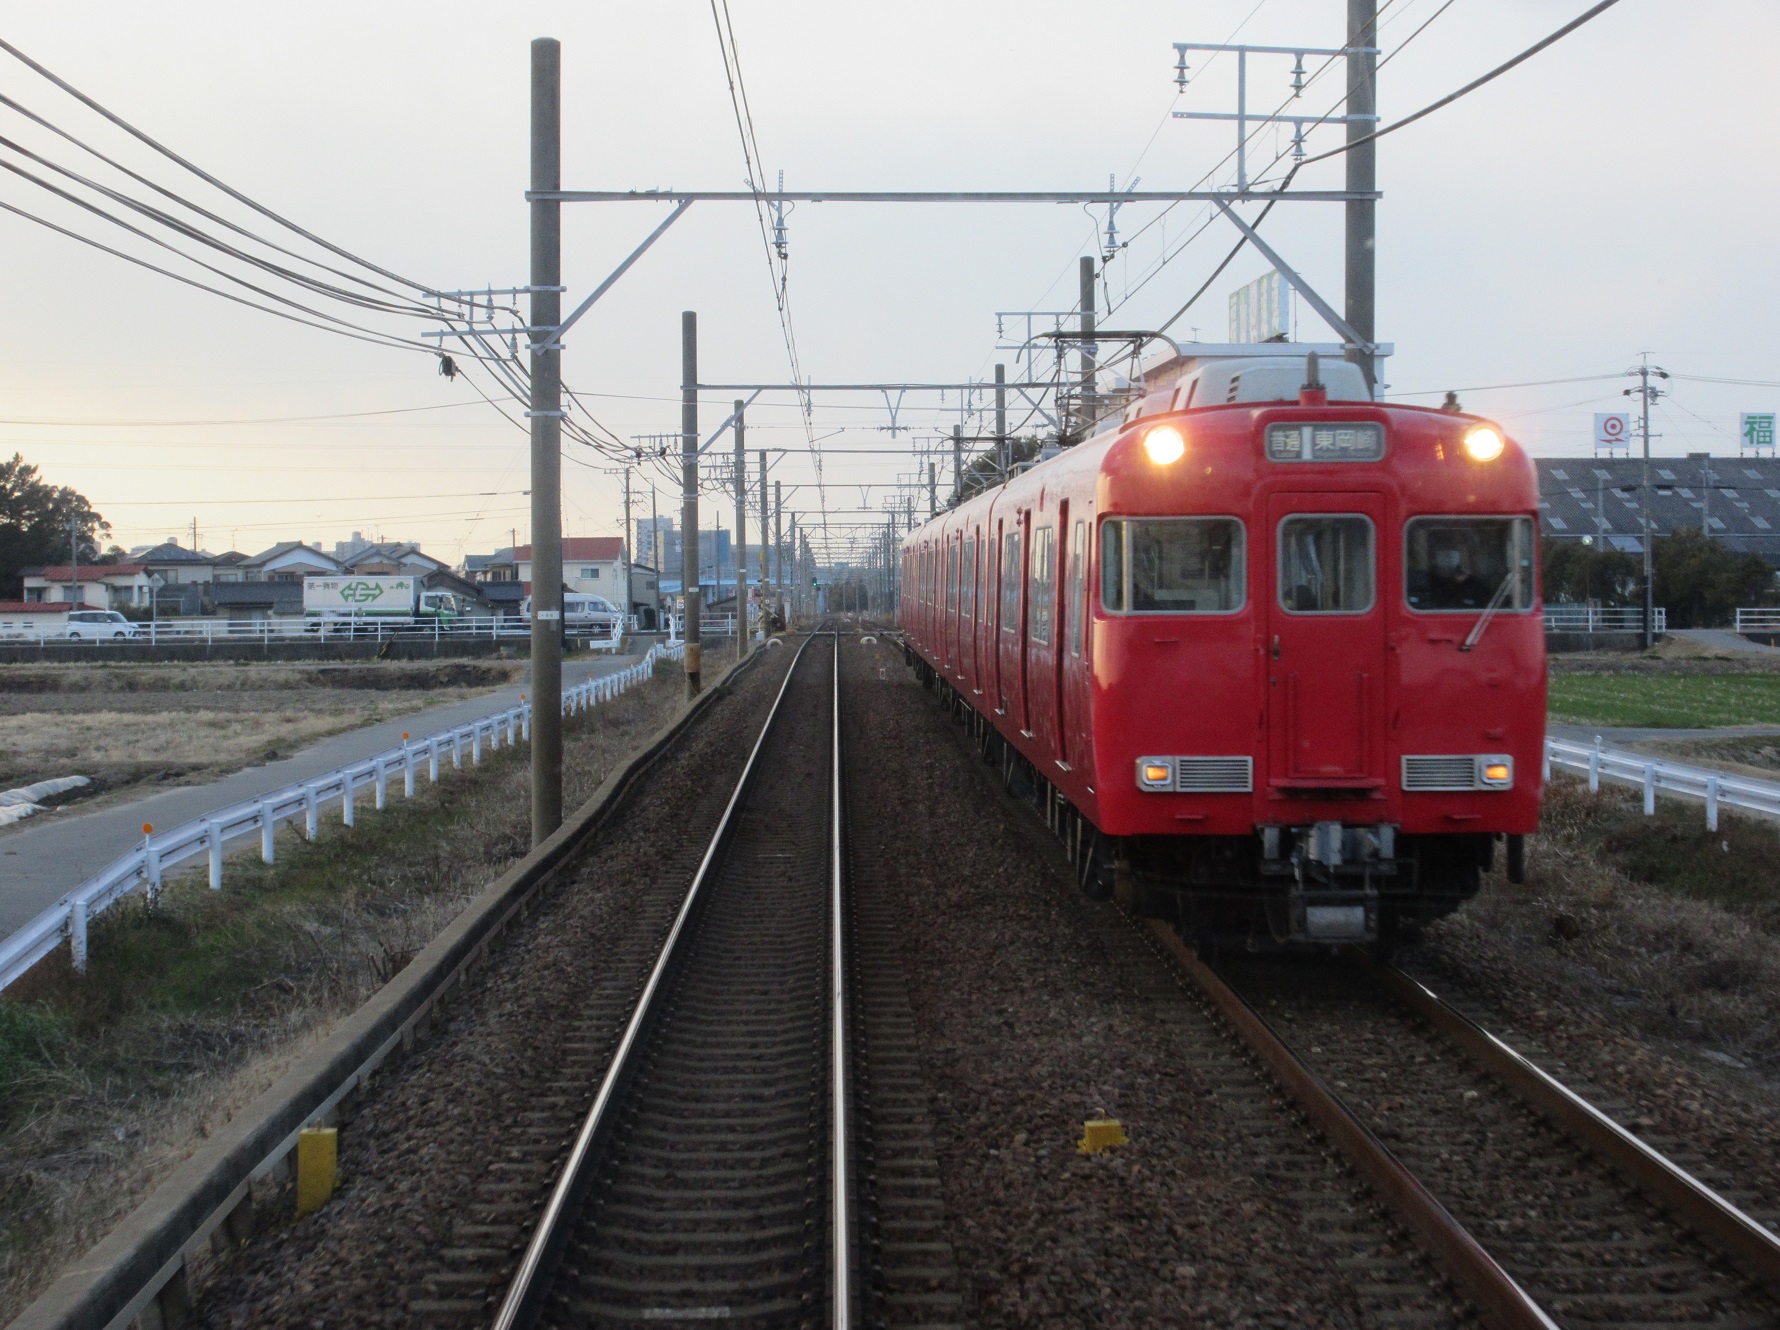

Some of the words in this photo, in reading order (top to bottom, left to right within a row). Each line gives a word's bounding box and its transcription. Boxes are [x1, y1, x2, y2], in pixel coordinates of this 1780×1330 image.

[1271, 430, 1300, 450] 普通
[1314, 430, 1377, 450] 東岡崎
[1743, 415, 1774, 445] 福
[307, 582, 339, 591] 第一貨物
